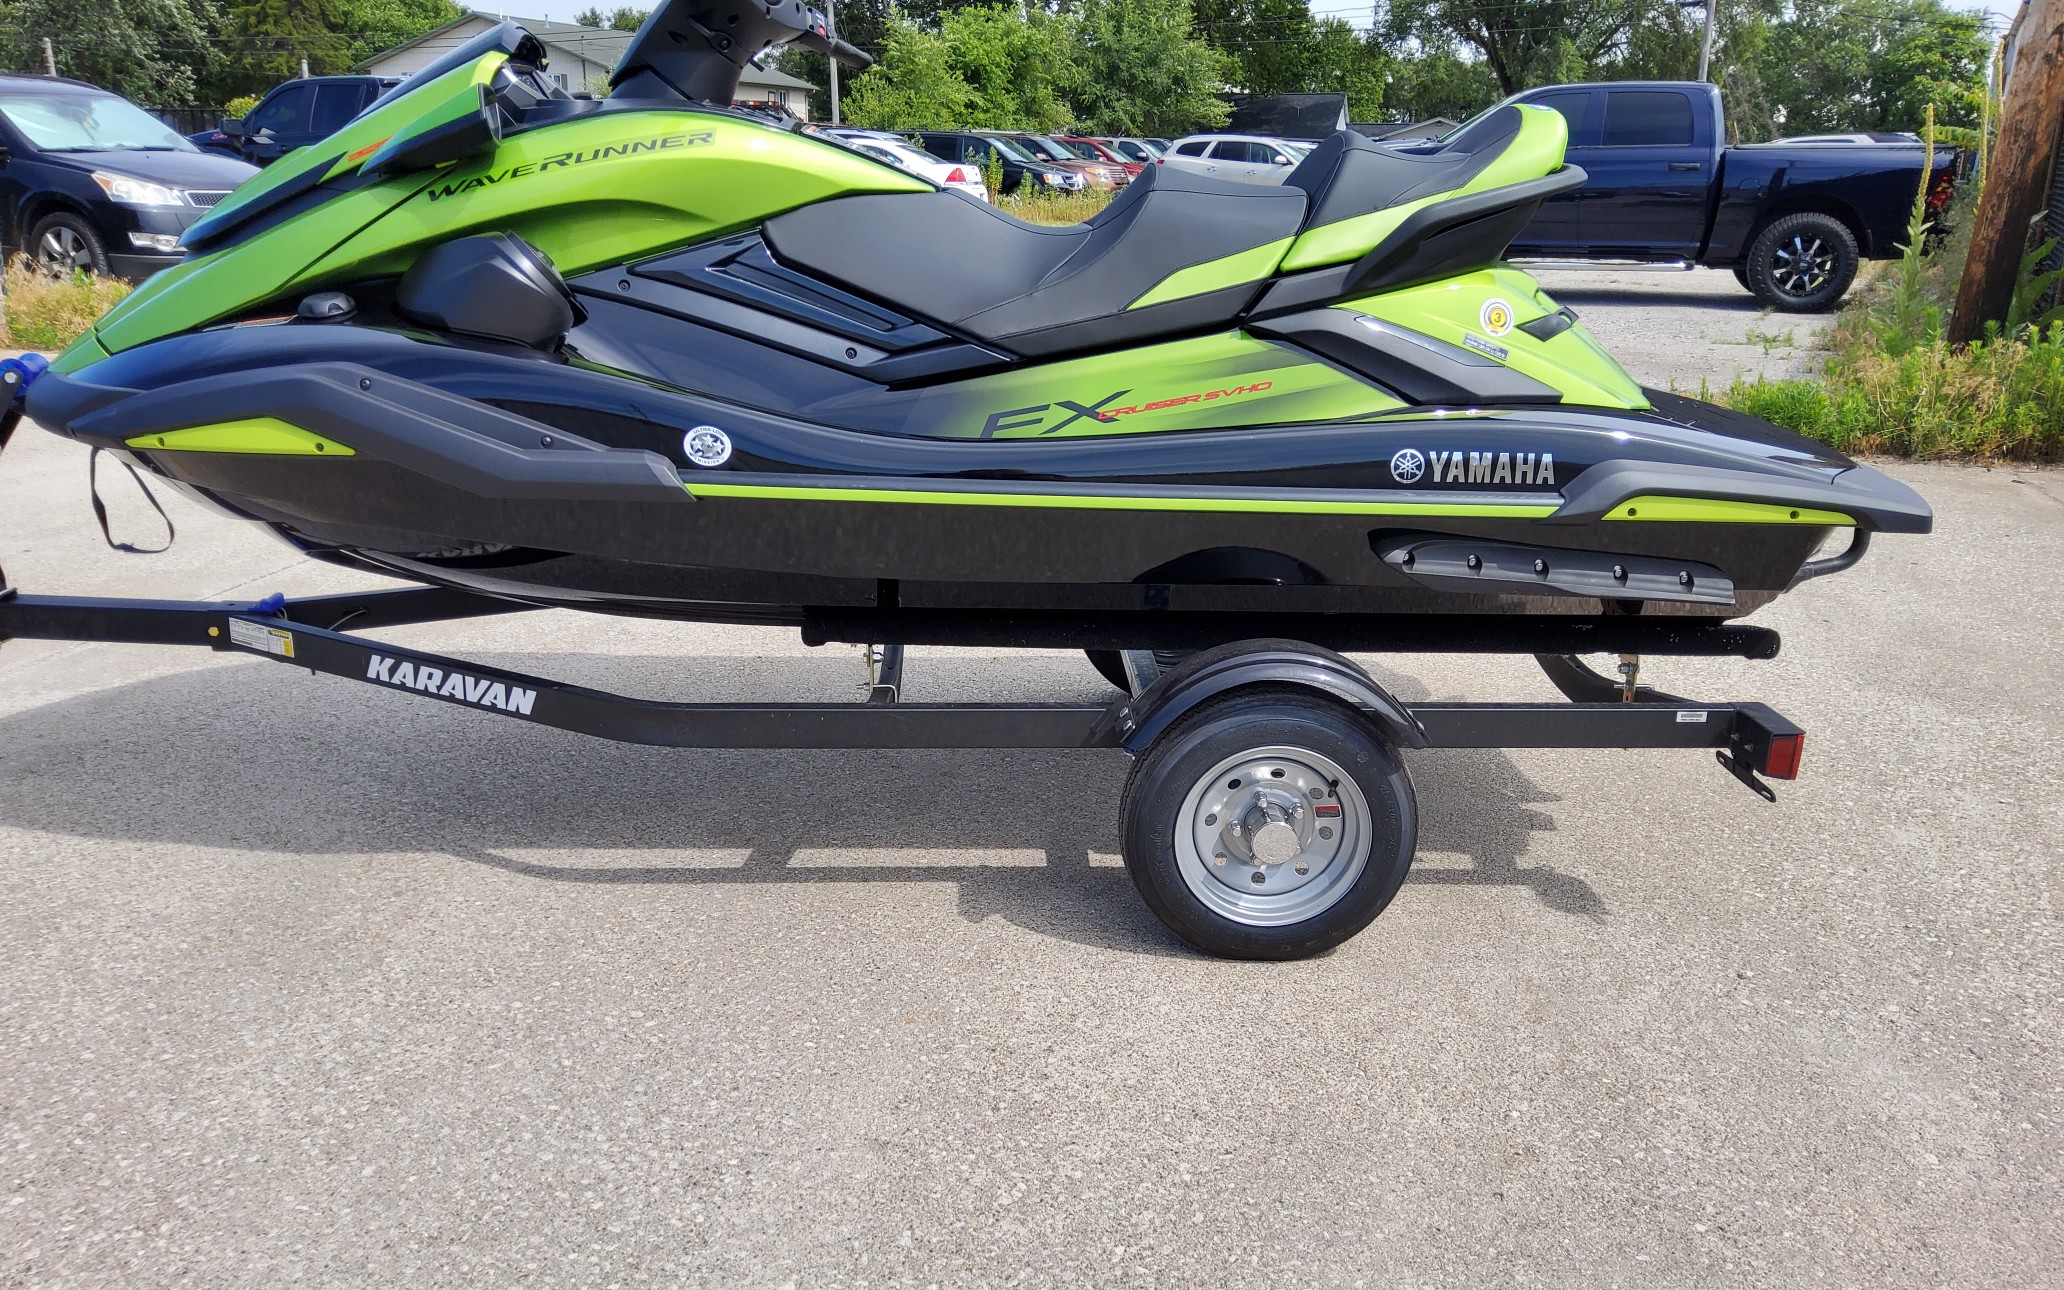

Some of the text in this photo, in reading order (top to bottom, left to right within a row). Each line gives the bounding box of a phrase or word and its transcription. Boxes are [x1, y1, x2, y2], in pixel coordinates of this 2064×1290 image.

[427, 132, 714, 202] WAVERUNNER
[1494, 312, 1502, 323] 3
[980, 381, 1273, 438] FX CRUISER SVHO
[1429, 451, 1555, 485] YAMAHA
[367, 654, 538, 716] KARAVAN
